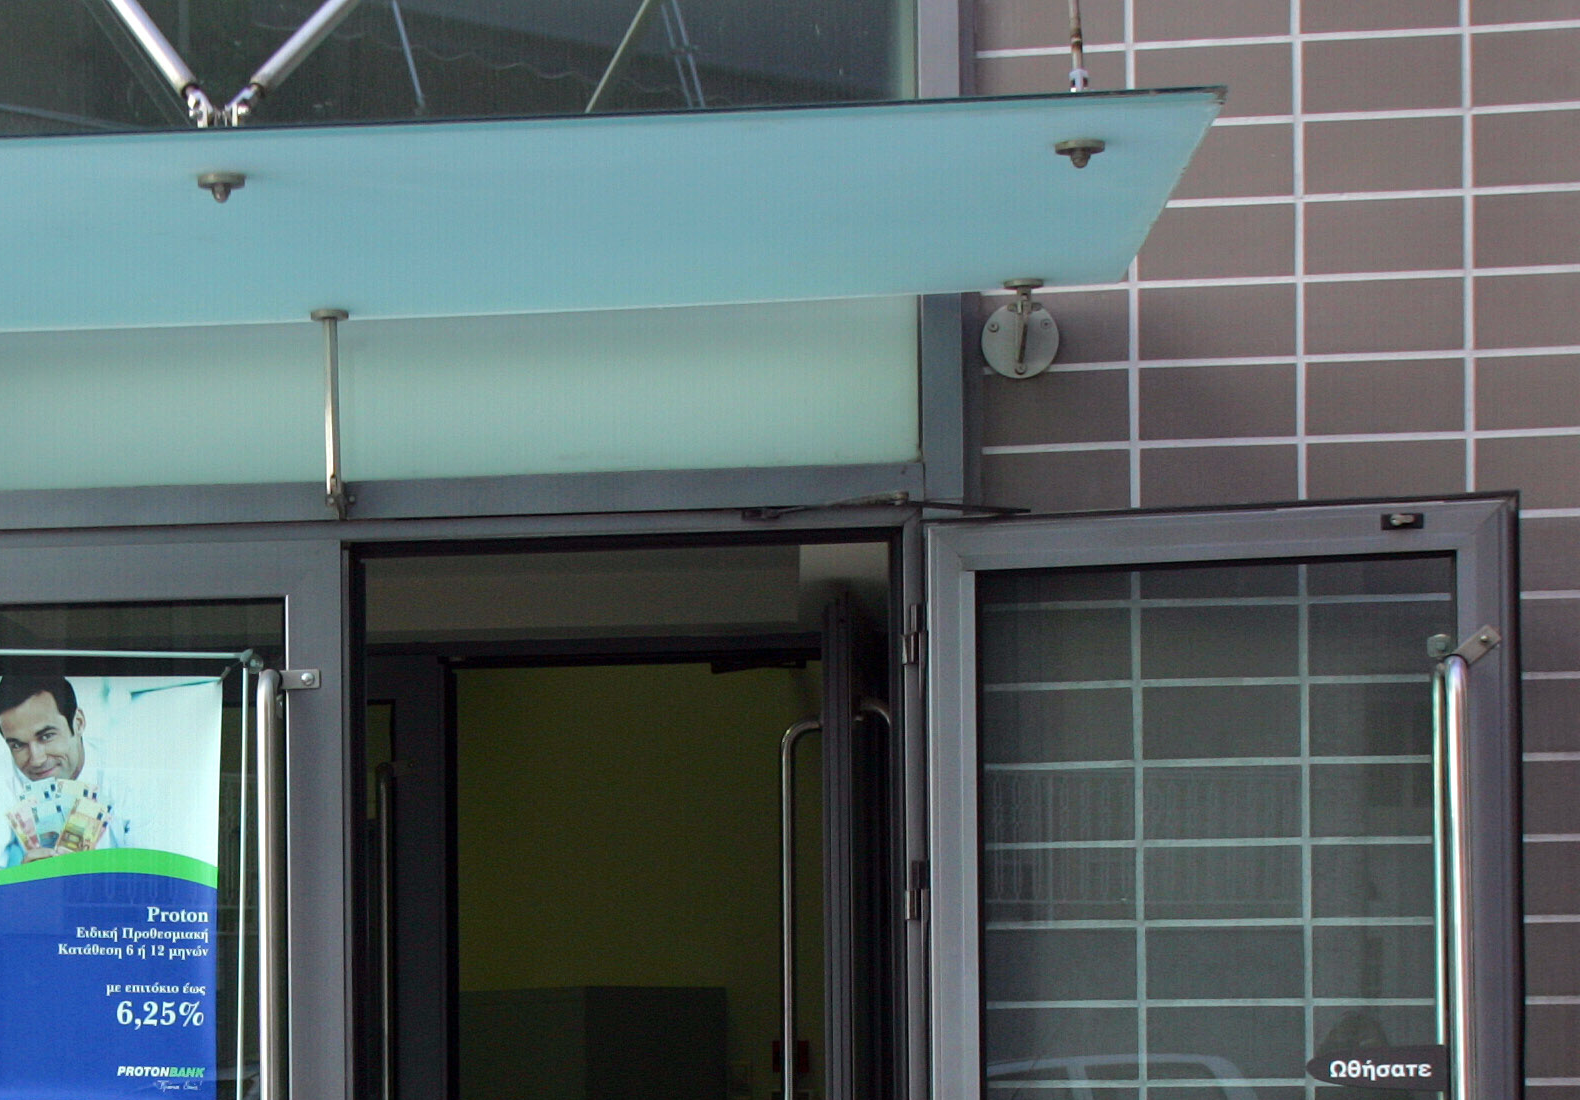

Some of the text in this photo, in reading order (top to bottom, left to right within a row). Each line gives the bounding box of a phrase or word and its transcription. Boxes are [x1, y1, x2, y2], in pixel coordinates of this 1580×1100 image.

[146, 906, 209, 923] Proton
[76, 926, 209, 943] Ειδική Προθεσμιακή
[58, 943, 209, 960] Κατάθεση 6 ή 12 μηνών
[106, 982, 206, 996] με επιτόκιο έως
[116, 1000, 205, 1030] 6,25%
[117, 1066, 206, 1078] PROTONBANK
[1329, 1060, 1432, 1081] Ωθήσατε
